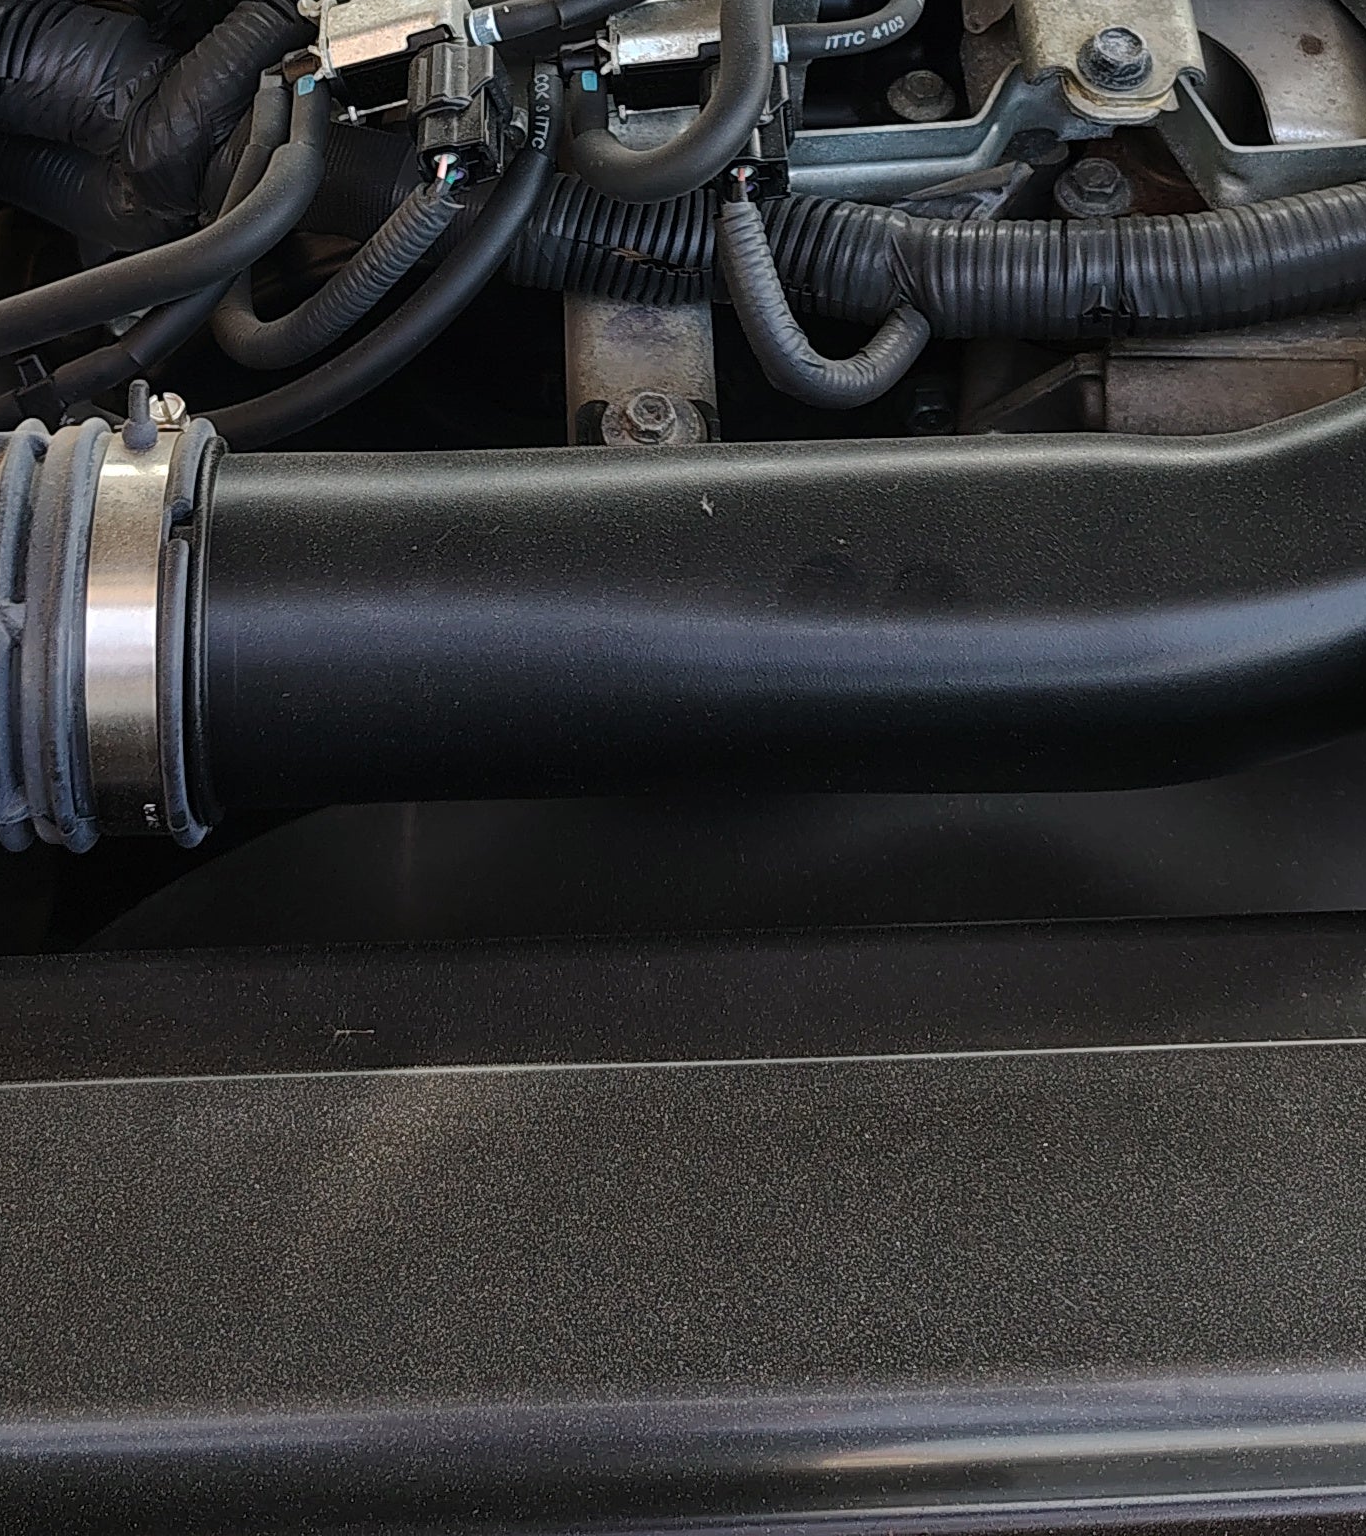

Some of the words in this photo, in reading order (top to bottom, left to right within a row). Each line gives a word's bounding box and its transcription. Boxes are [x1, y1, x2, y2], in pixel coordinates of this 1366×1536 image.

[824, 30, 866, 51] ITTC
[871, 15, 905, 40] 4103
[531, 115, 551, 150] ITTC
